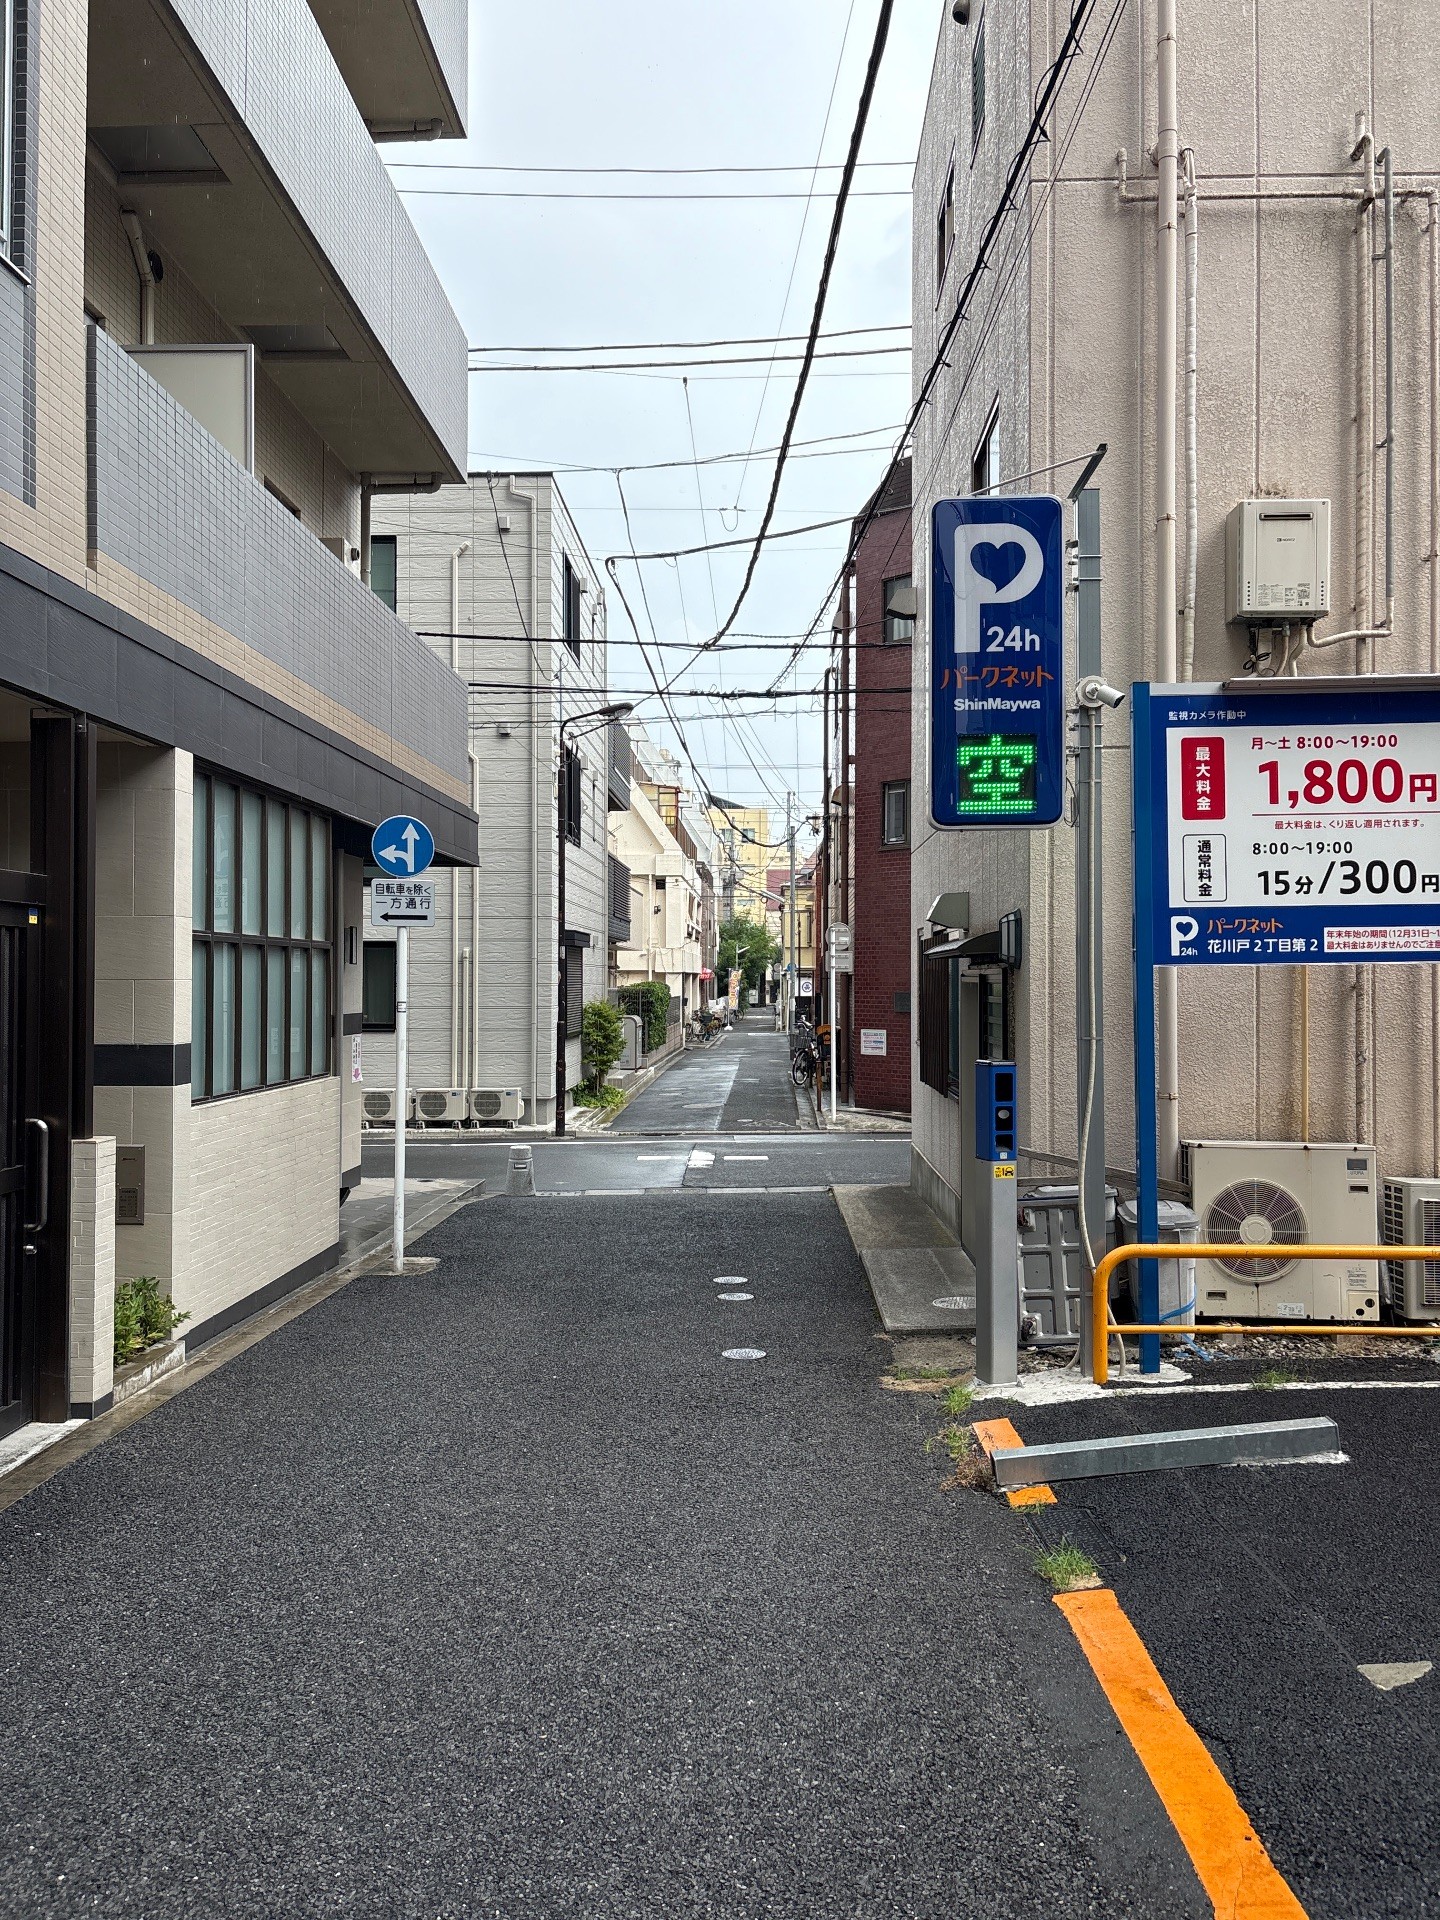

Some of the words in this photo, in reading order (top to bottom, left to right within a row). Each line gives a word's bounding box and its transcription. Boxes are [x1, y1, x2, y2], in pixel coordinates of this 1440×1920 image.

[954, 524, 1044, 653] P
[986, 626, 1040, 652] 24h
[940, 665, 1054, 689] パークネット
[953, 697, 1041, 711] ShinMaywa
[1168, 710, 1247, 721] 監視カメラ作動中
[957, 735, 1037, 815] 空
[1195, 747, 1211, 811] 最大料金
[1258, 758, 1438, 809] 1,800円
[1274, 819, 1425, 829] 最大料金は、くり返し適用されます。
[1197, 840, 1212, 897] 通常料金
[375, 883, 431, 895] 自転車を除く
[375, 897, 431, 909] 一方通行
[1207, 918, 1283, 934] パークネット
[1180, 948, 1198, 956] 24h
